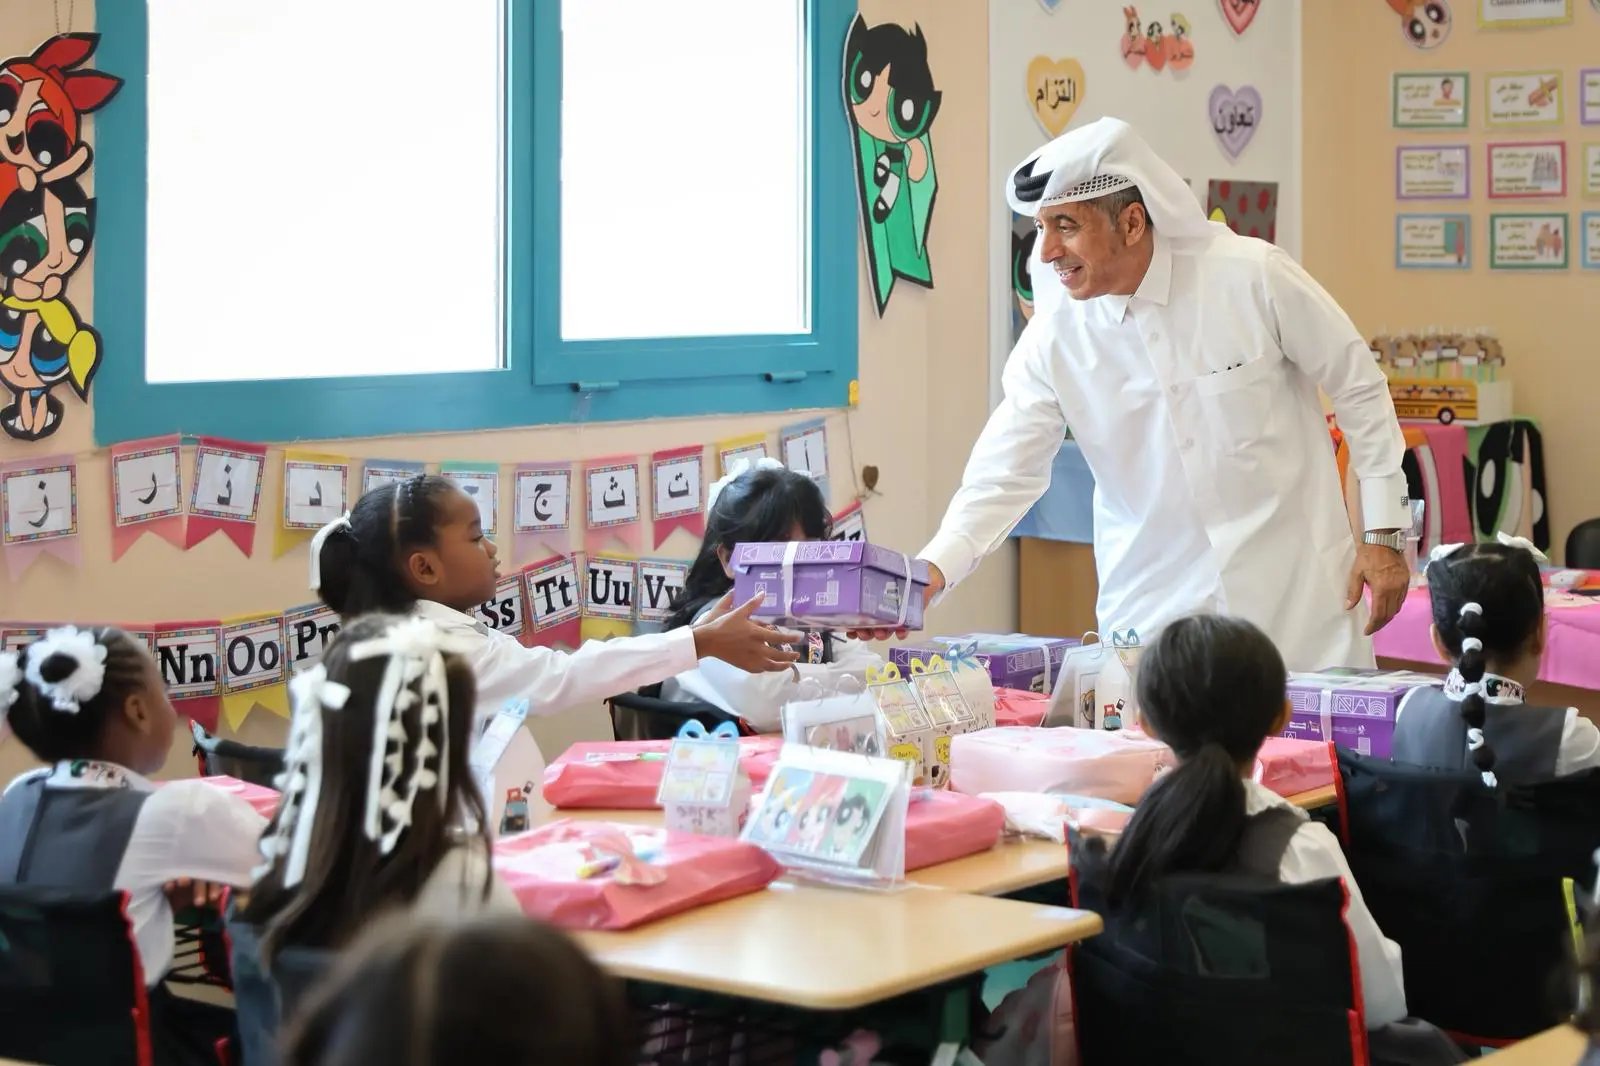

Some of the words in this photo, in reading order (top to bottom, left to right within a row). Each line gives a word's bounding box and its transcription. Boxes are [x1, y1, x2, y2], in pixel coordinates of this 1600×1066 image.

[1035, 77, 1077, 112] التزام
[1213, 105, 1255, 134] تعاون
[138, 471, 158, 505] ر
[216, 463, 233, 506] ذ
[308, 480, 323, 507] د
[533, 481, 553, 522] ج
[602, 476, 626, 509] ث
[667, 471, 689, 499] ت
[28, 479, 50, 528] ز
[535, 576, 570, 616] Tt
[589, 568, 631, 607] Uu
[480, 597, 515, 629] Ss
[159, 645, 216, 685] Nn
[226, 634, 280, 677] Oo
